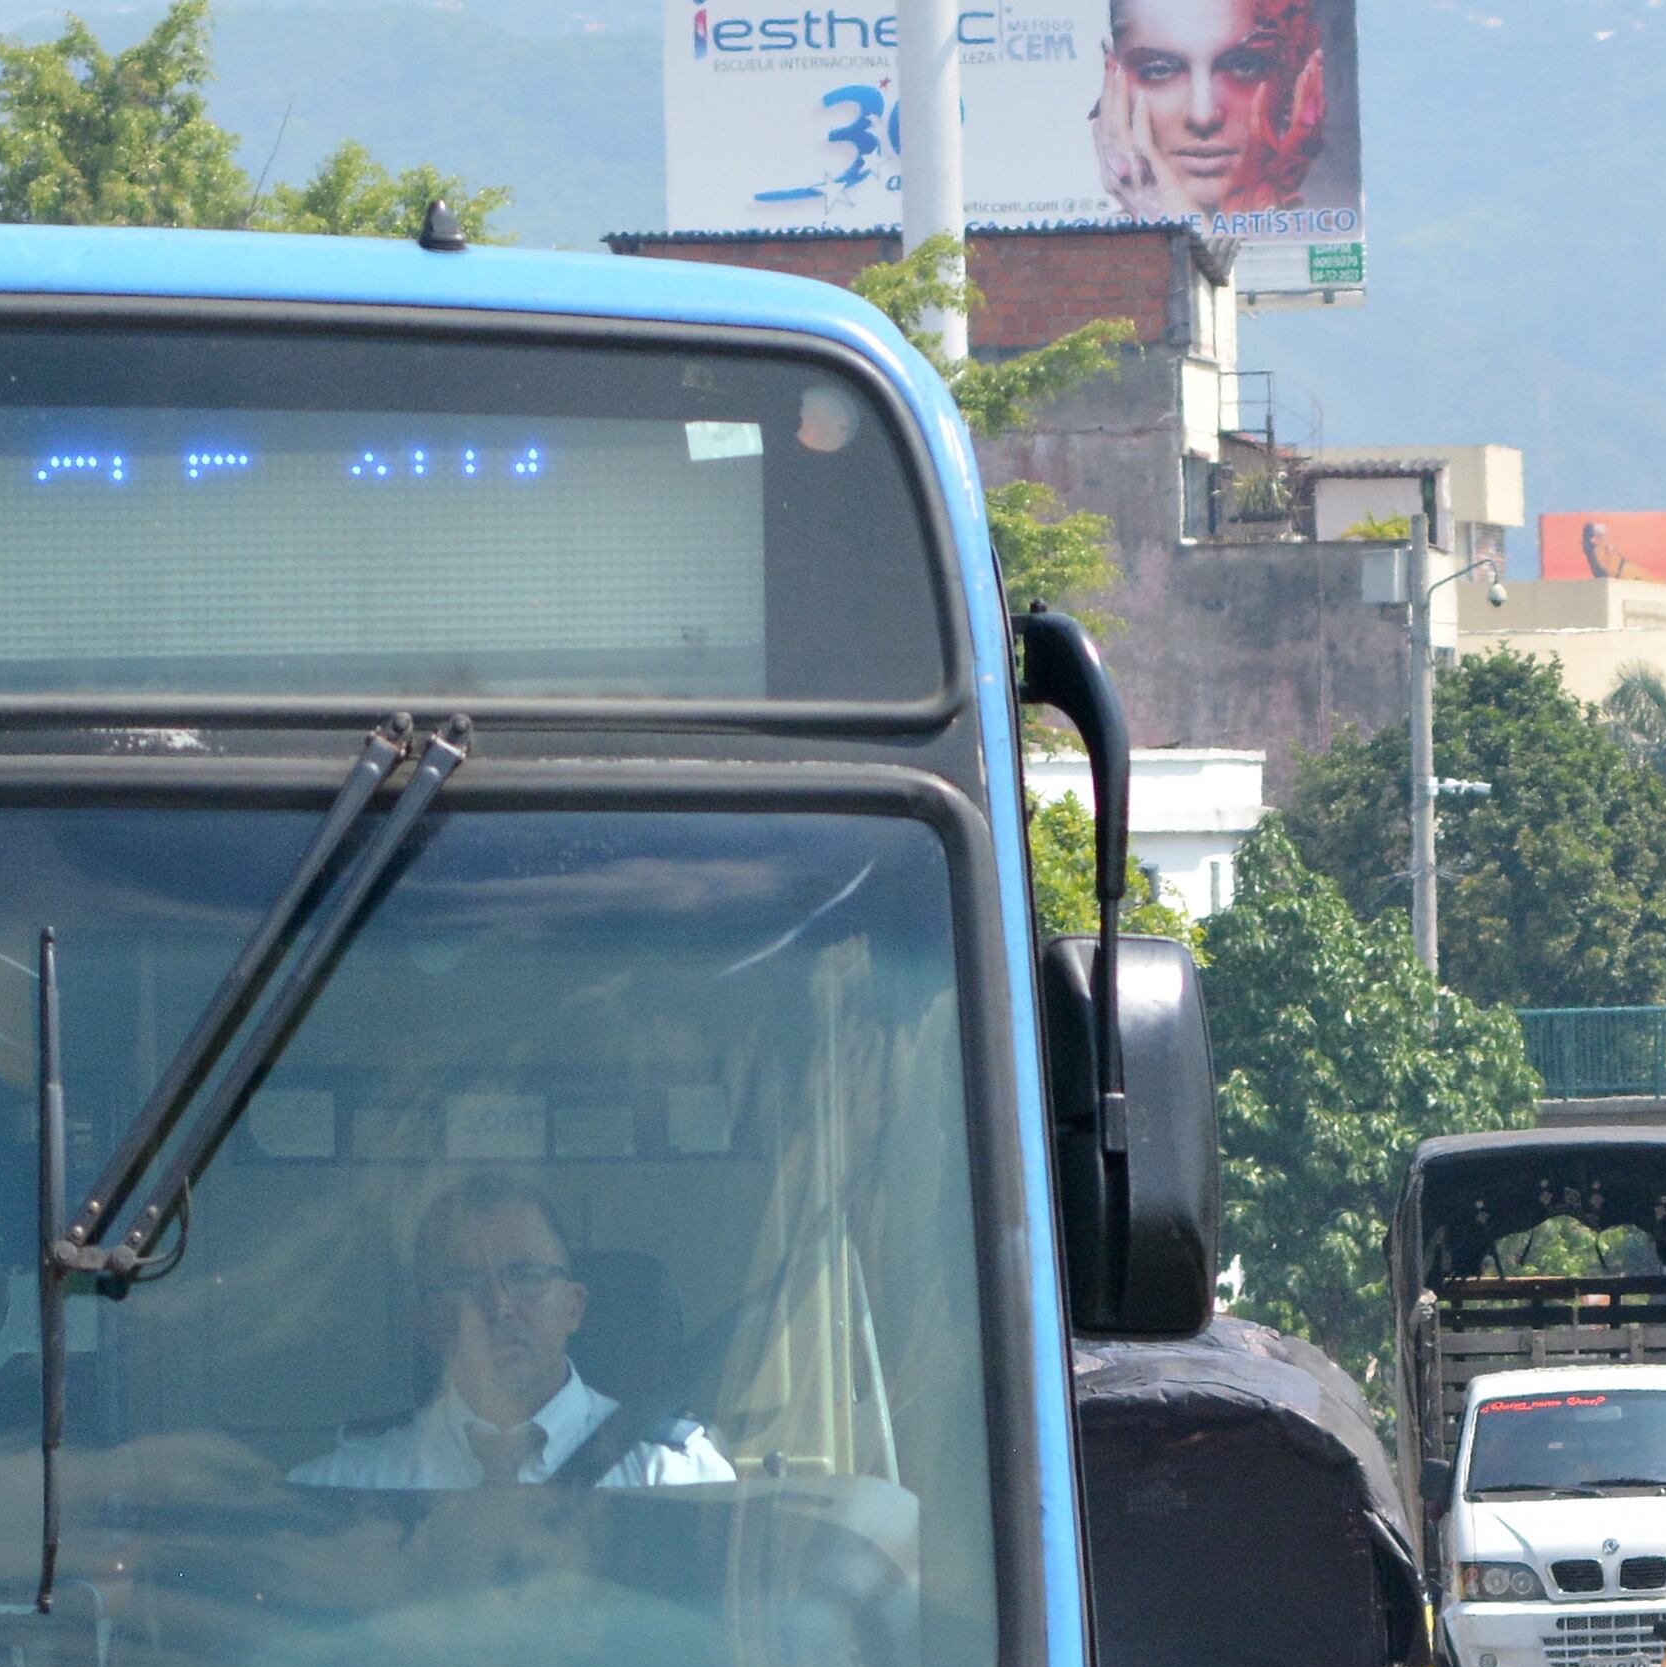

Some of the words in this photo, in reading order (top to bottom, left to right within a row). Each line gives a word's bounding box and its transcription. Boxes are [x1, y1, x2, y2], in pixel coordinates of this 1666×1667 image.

[693, 0, 995, 59] iesthec
[1006, 33, 1077, 62] CEM
[713, 59, 775, 73] ESCUELA
[781, 55, 891, 70] INTERNACIONAL
[1211, 207, 1358, 236] ARTÍSTICO
